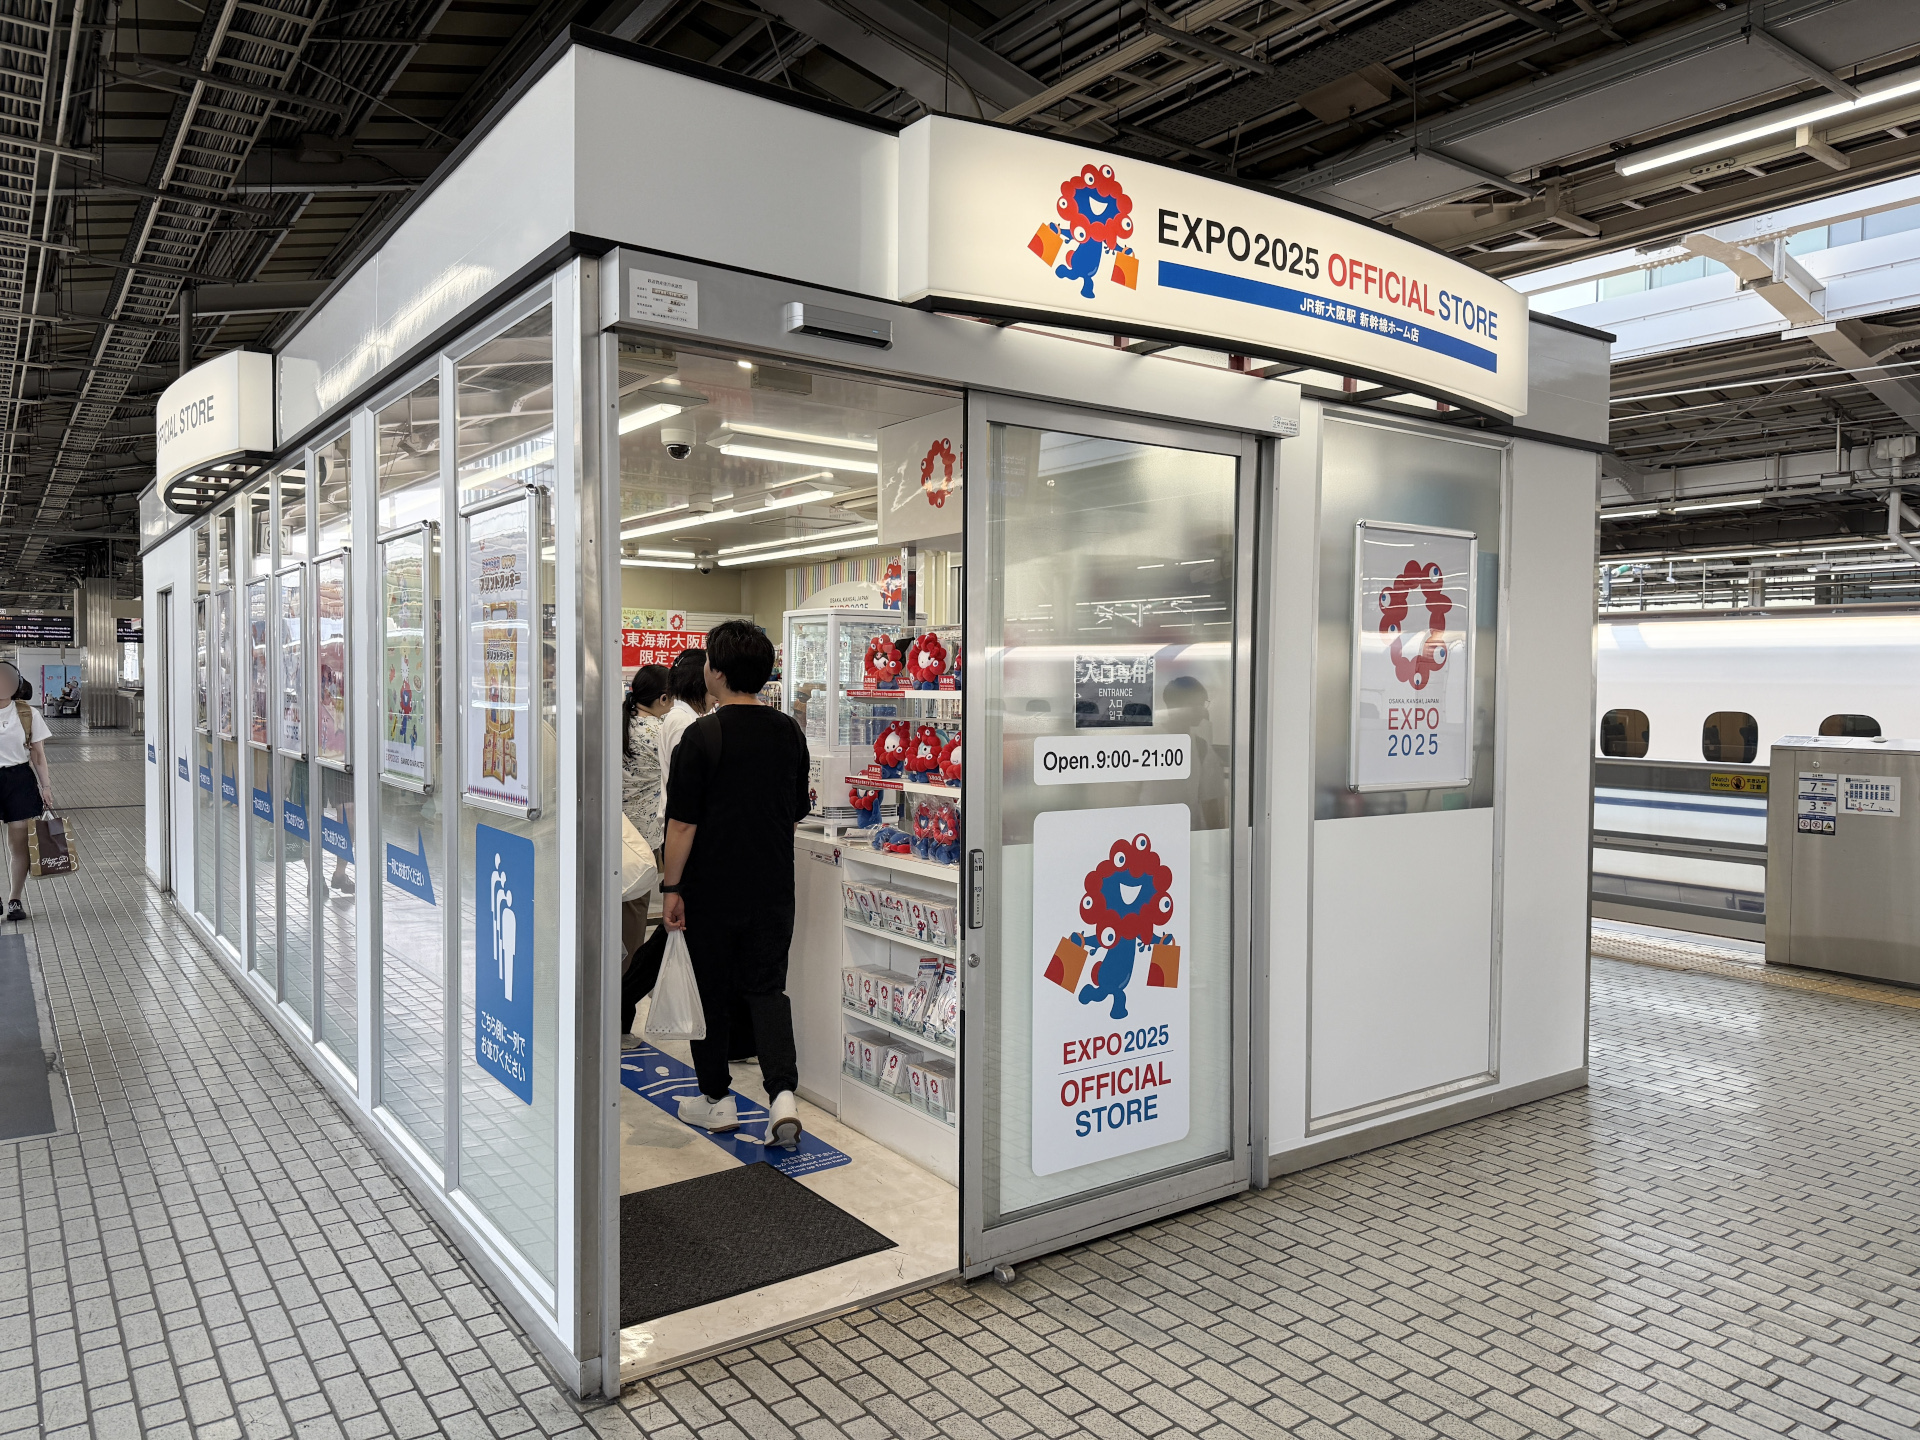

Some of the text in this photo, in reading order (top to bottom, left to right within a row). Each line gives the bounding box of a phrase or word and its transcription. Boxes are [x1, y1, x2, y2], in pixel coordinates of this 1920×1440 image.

[1158, 208, 1498, 340] EXPO2025 OFFICIAL STORE
[1300, 297, 1420, 343] JR新大阪駅 新幹線ホーム店
[180, 395, 214, 434] STORE
[1083, 664, 1147, 683] 入口専用
[1099, 688, 1133, 697] ENTRANCE
[1109, 699, 1123, 708] 入口
[1109, 711, 1123, 720] 입구
[1388, 707, 1440, 730] EXPO
[1388, 734, 1438, 756] 2025
[1810, 783, 1817, 791] 7
[1810, 802, 1816, 810] 3
[481, 1011, 525, 1057] こちら側に一列で
[481, 1035, 526, 1081] お並びください
[1060, 1061, 1172, 1107] OFFICIAL
[1075, 1094, 1158, 1137] STORE
